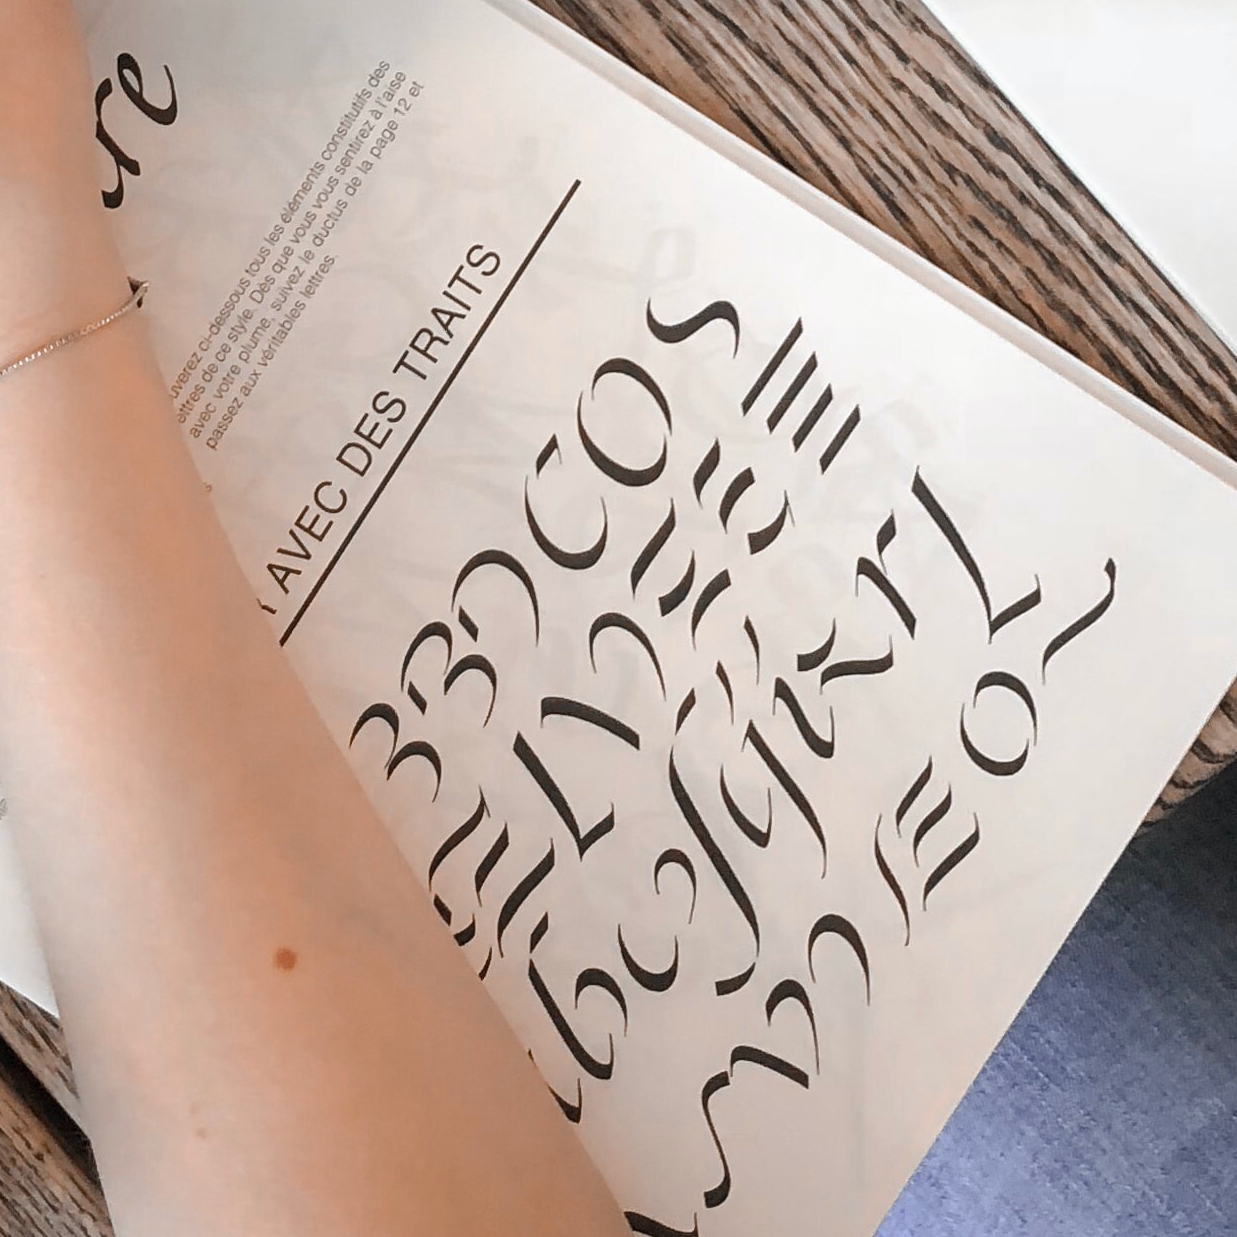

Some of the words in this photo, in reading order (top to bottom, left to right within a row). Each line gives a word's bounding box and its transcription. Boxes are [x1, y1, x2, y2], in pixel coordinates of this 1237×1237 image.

[177, 383, 206, 424] ettres
[201, 362, 219, 383] de
[214, 342, 232, 363] ce
[248, 274, 276, 305] Dès
[271, 245, 295, 275] que
[289, 210, 318, 244] vous
[311, 175, 340, 210] vous
[334, 119, 376, 176] sentirez
[368, 108, 385, 123] à
[189, 402, 217, 439] avec
[213, 364, 242, 399] votre
[270, 265, 306, 312] suivez
[297, 249, 316, 265] le
[311, 198, 349, 248] ductus
[344, 176, 362, 197] de
[355, 159, 375, 175] la
[369, 119, 399, 160] page
[393, 96, 413, 118] 12
[408, 80, 425, 98] et
[198, 277, 251, 352] ci-dessous
[244, 246, 271, 278] tous
[263, 224, 285, 247] les
[280, 161, 326, 225] éléments
[320, 88, 373, 161] constitutifs
[367, 60, 391, 88] des
[205, 396, 244, 452] passez
[239, 368, 263, 397] aux
[256, 299, 307, 367] véritables
[266, 480, 348, 595] AVEC
[335, 390, 407, 478] DES
[392, 244, 501, 381] TRAITS
